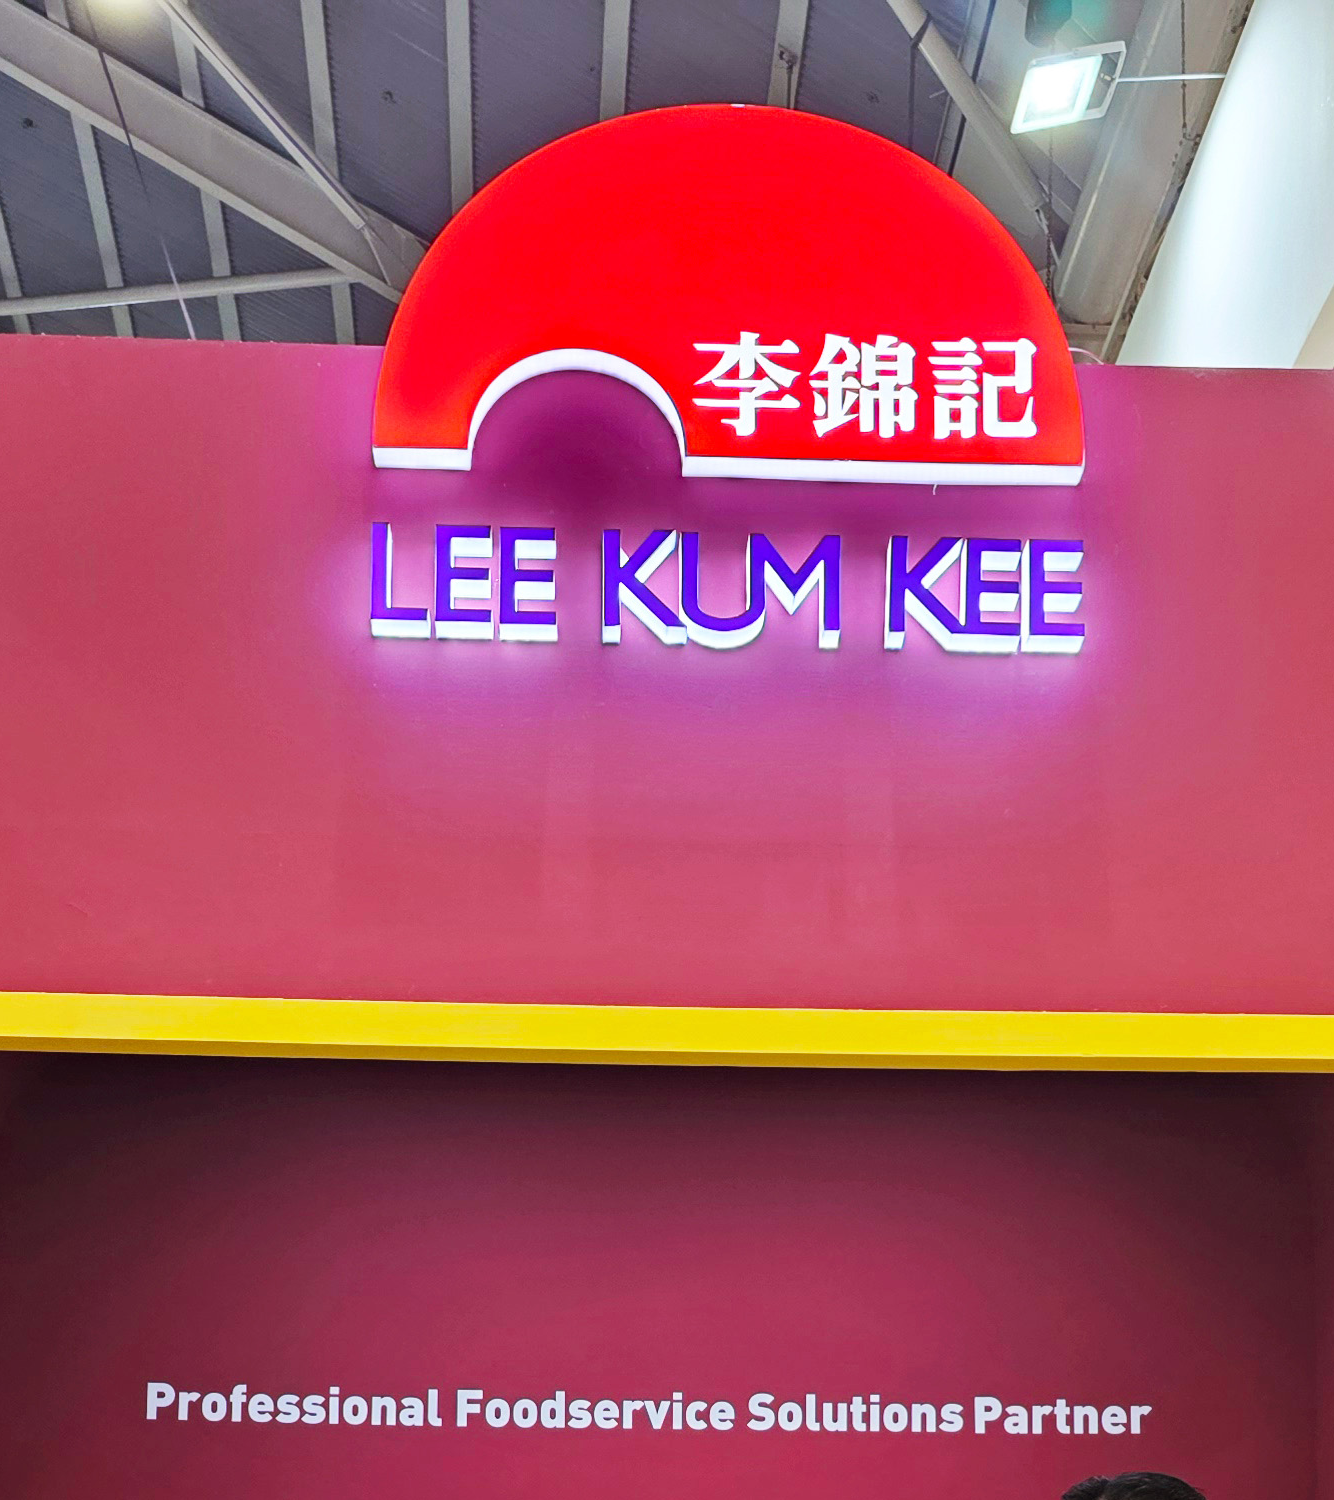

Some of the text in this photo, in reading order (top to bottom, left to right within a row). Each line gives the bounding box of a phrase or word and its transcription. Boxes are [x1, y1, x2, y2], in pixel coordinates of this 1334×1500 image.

[693, 330, 1037, 440] 李錦記
[370, 521, 1086, 654] LEE KUM KEE
[146, 1381, 1153, 1435] Professional Foodservice Solutions Partner
